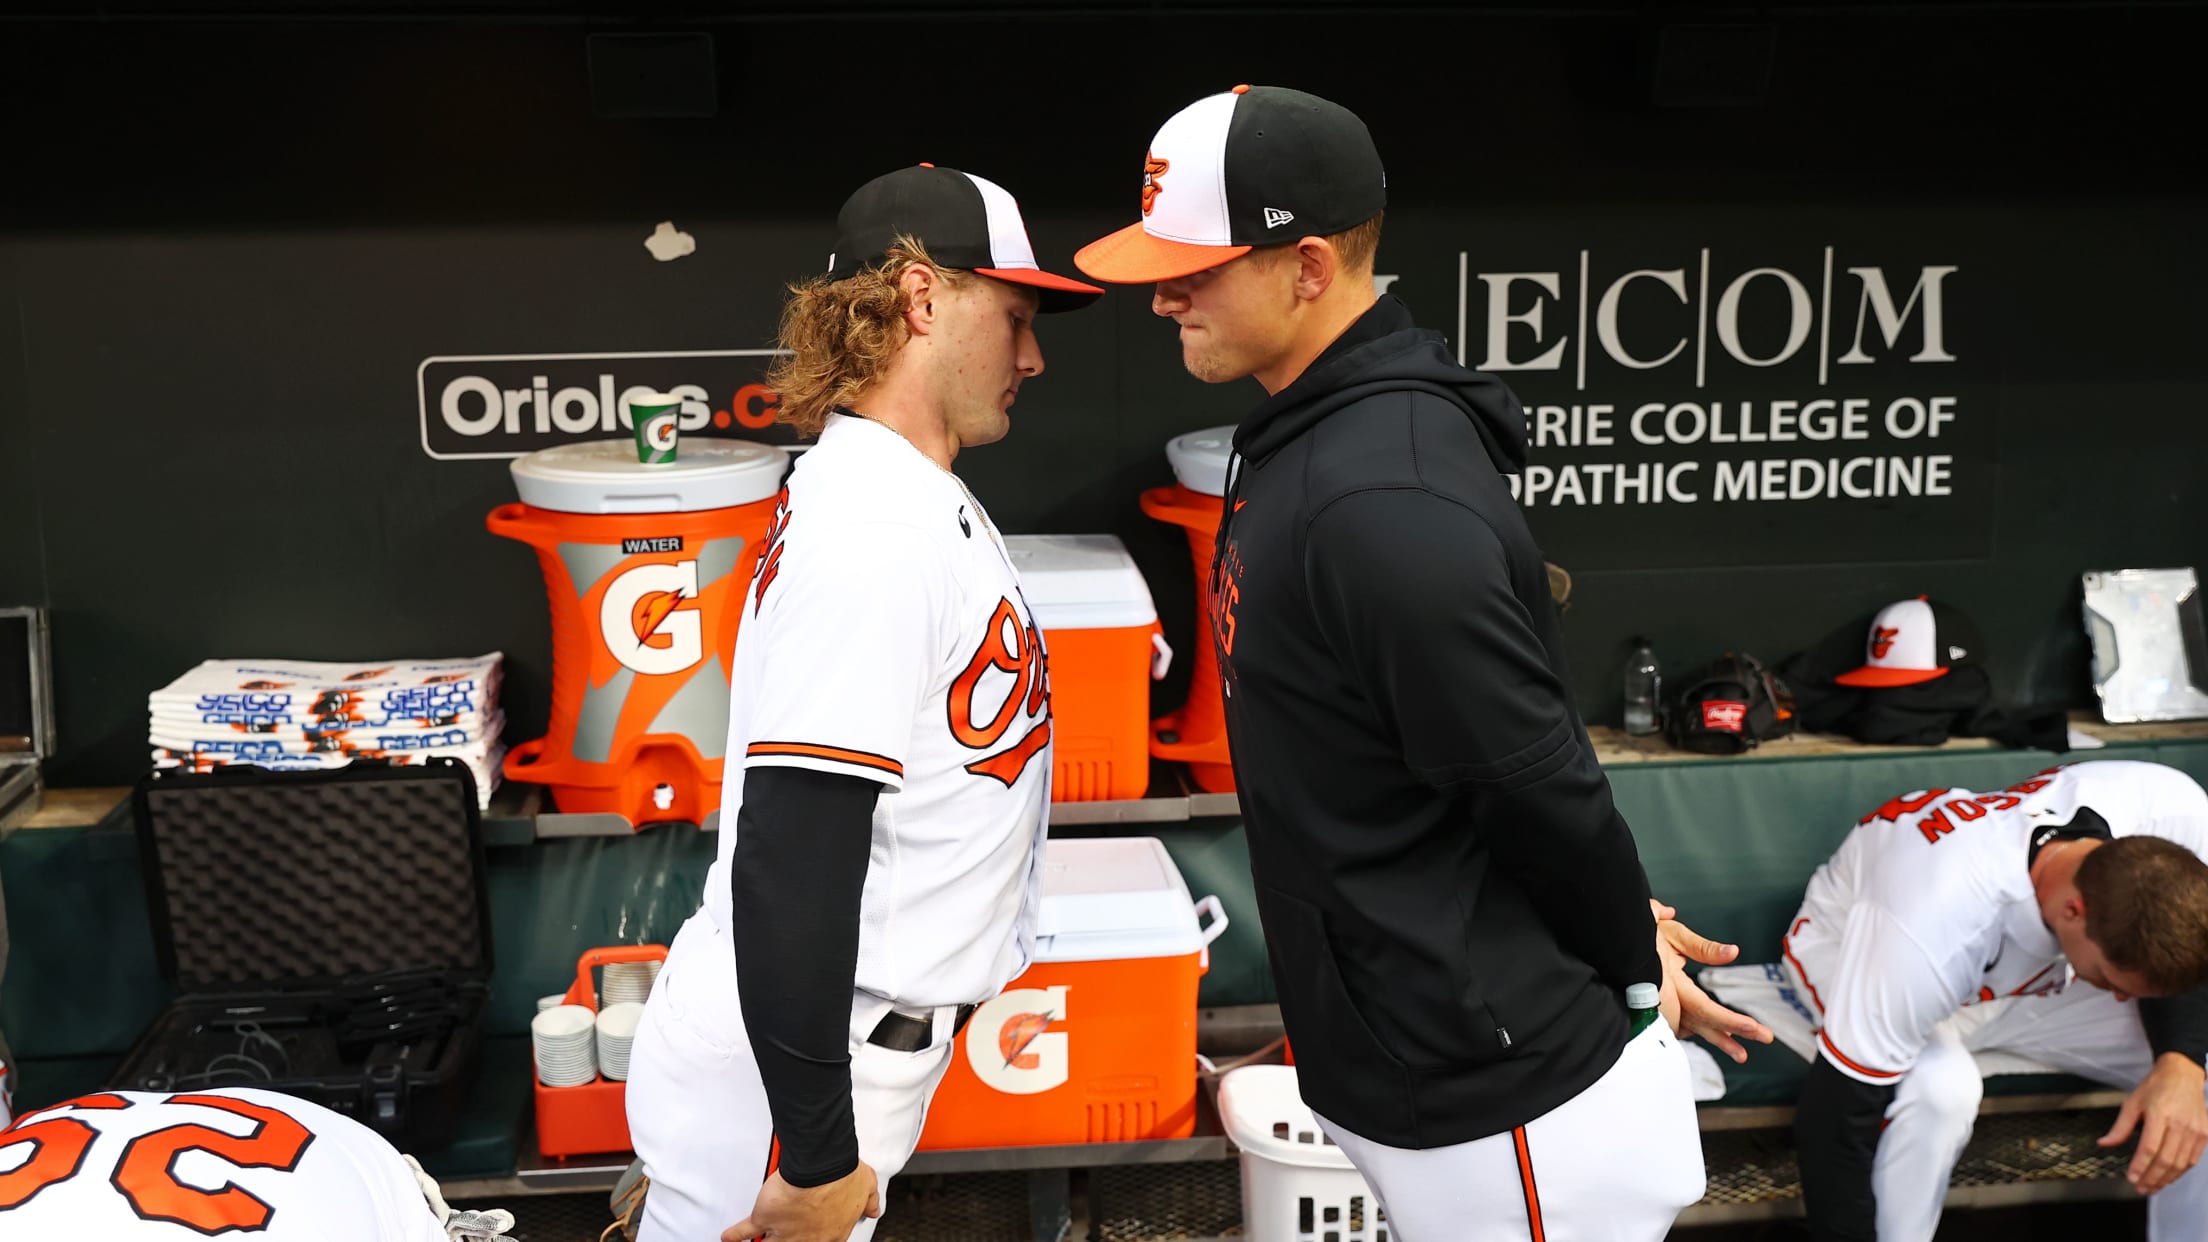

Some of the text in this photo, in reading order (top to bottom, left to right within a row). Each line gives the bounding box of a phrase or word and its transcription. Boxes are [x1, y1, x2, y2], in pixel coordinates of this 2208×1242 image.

[1372, 266, 1959, 372] ECOM
[647, 413, 678, 452] G
[1629, 398, 1870, 445] COLLEGE
[1884, 396, 1958, 440] OF
[1713, 455, 1953, 502] MEDICINE
[624, 538, 680, 552] WATER
[600, 560, 704, 676] G
[966, 986, 1069, 1095] G
